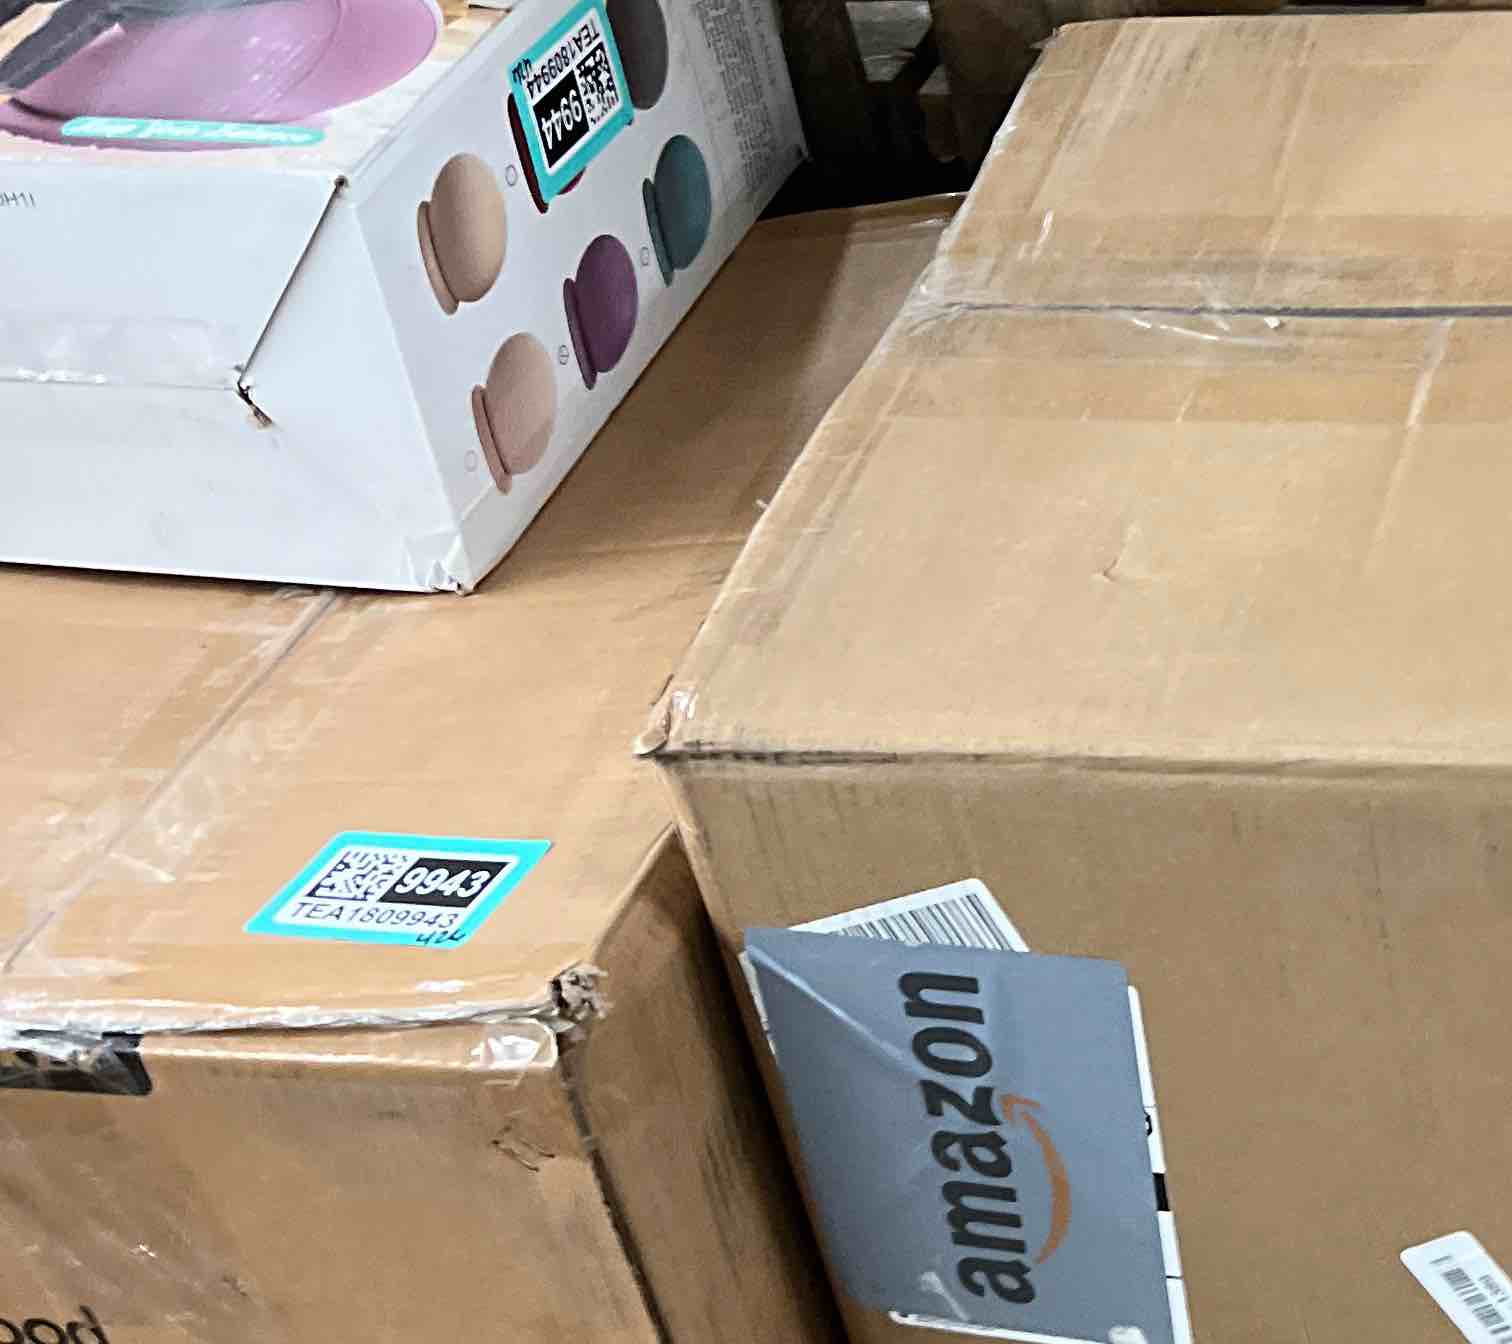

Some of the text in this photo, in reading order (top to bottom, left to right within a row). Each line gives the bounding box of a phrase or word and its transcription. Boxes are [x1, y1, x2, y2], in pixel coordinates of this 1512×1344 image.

[526, 18, 600, 99] TEA1809944
[541, 88, 584, 150] 9944
[394, 866, 492, 899] 9943
[291, 901, 459, 929] TEA1809943
[898, 970, 1037, 1305] amazon
